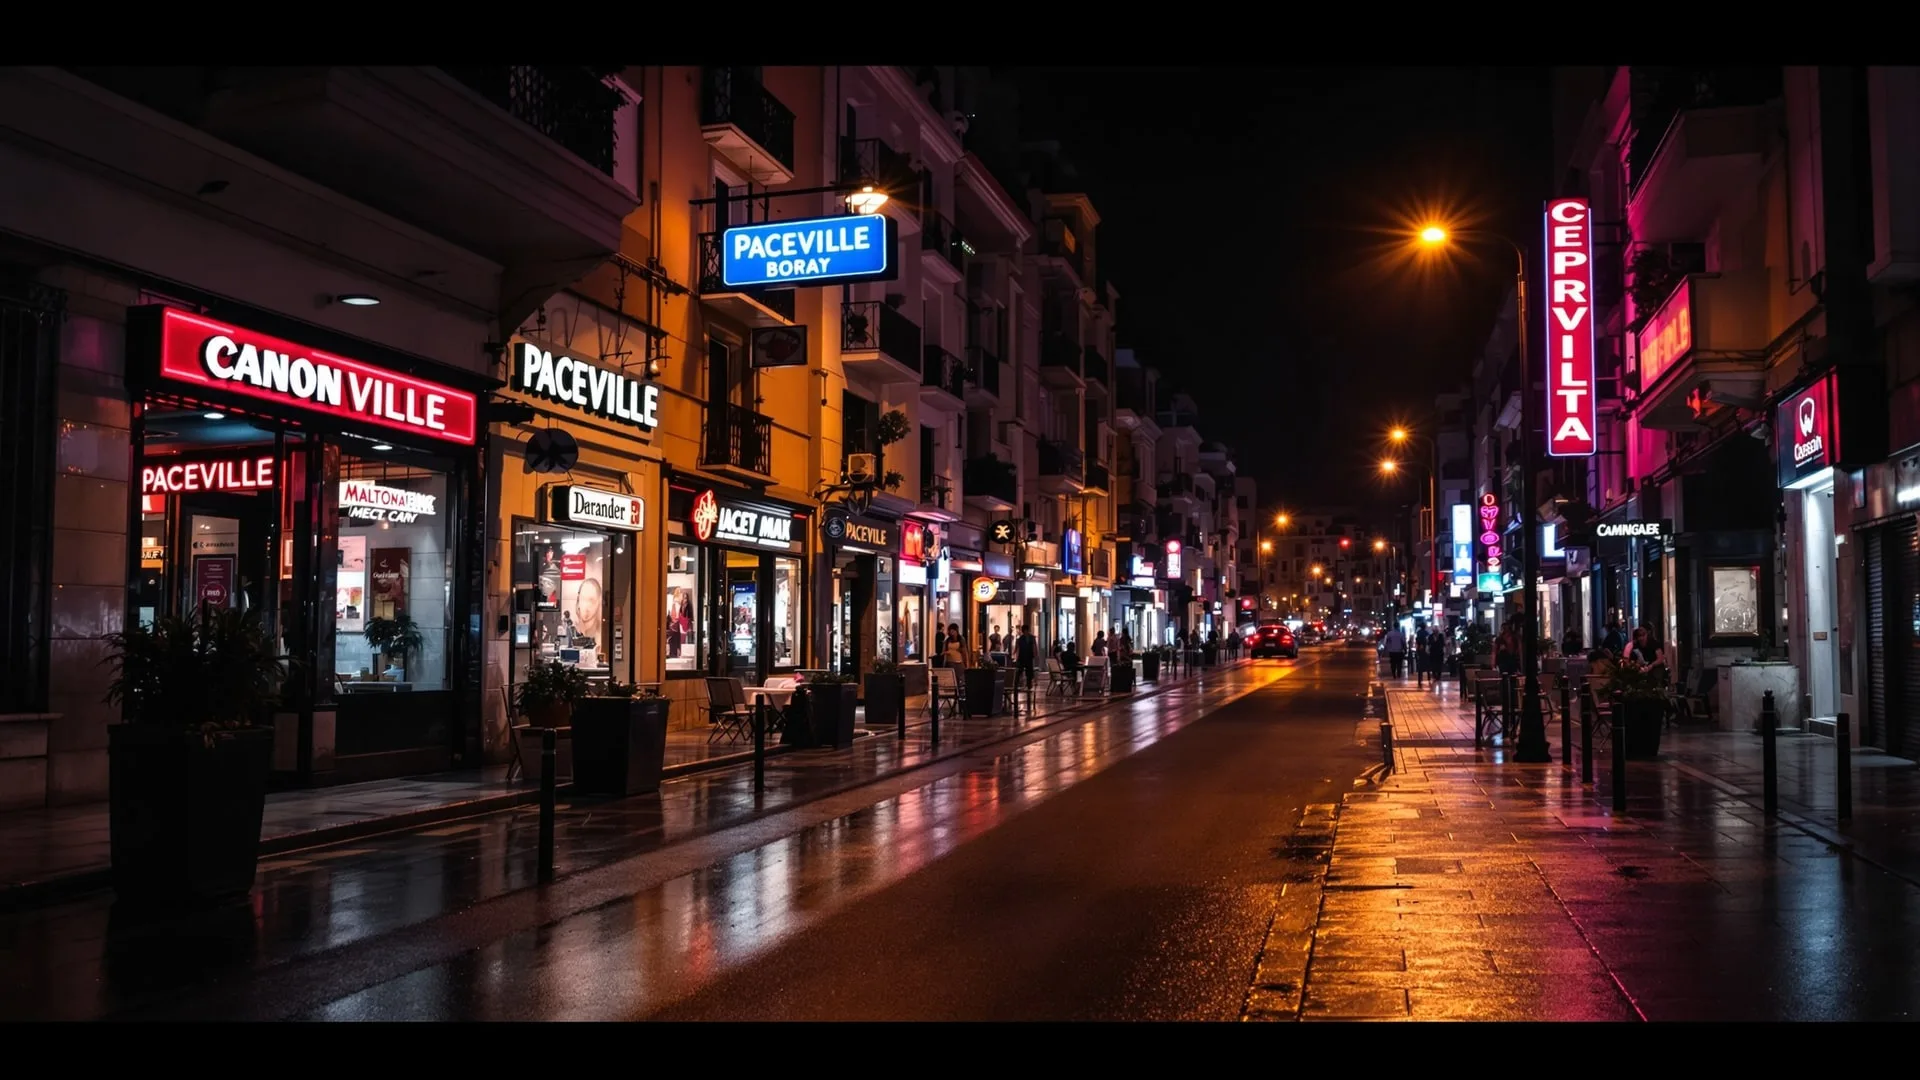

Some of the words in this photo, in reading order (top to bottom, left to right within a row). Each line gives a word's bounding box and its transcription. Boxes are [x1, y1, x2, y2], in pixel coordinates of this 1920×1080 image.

[734, 226, 870, 260] PACEVILLE
[766, 257, 831, 278] BORAY
[1551, 202, 1591, 441] CEPRVILTA
[205, 335, 342, 406] CANON
[349, 371, 446, 431] VILLE
[523, 343, 659, 427] PACEVILLE
[142, 458, 274, 492] PACEVILLE
[574, 491, 626, 521] Darander
